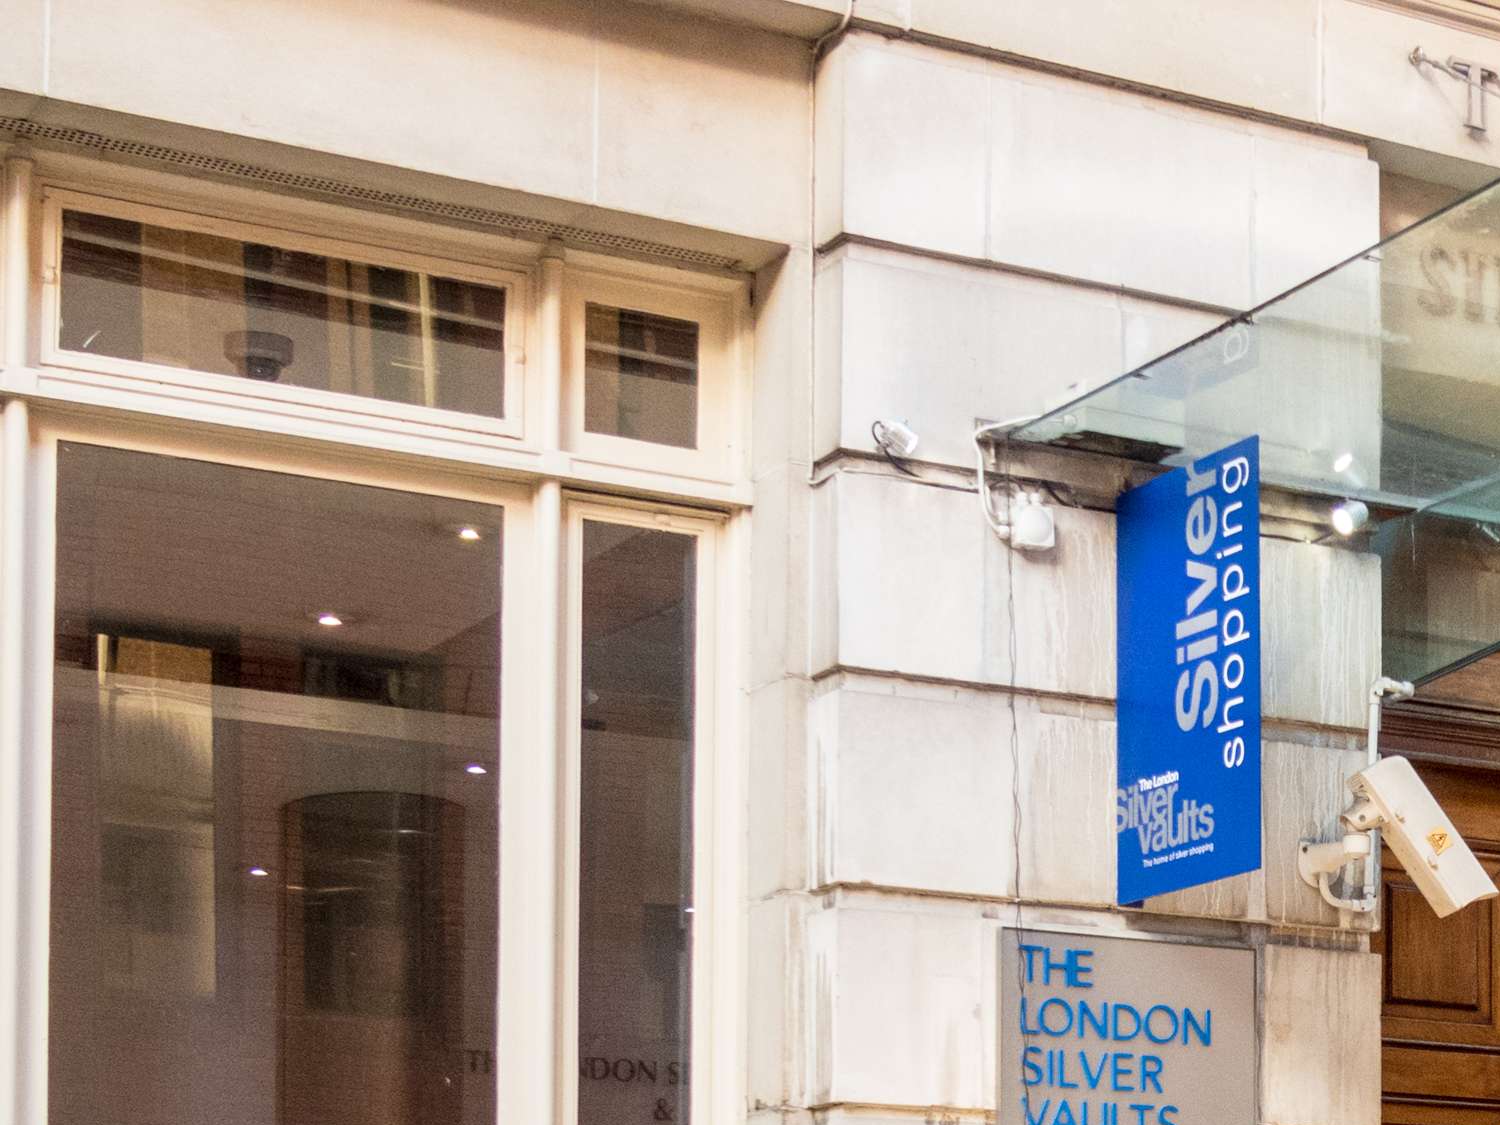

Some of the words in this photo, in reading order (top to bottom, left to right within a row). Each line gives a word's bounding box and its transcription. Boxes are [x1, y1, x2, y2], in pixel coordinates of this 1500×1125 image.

[1175, 455, 1220, 732] Silver
[1217, 455, 1250, 769] shopping
[1153, 770, 1179, 787] London
[1116, 783, 1179, 833] Silver
[1138, 799, 1215, 855] vaults
[1189, 842, 1214, 857] shopping
[1018, 944, 1094, 988] THE
[1020, 996, 1212, 1047] LONDON
[1021, 1046, 1163, 1094] SILVER
[652, 1097, 674, 1122] &
